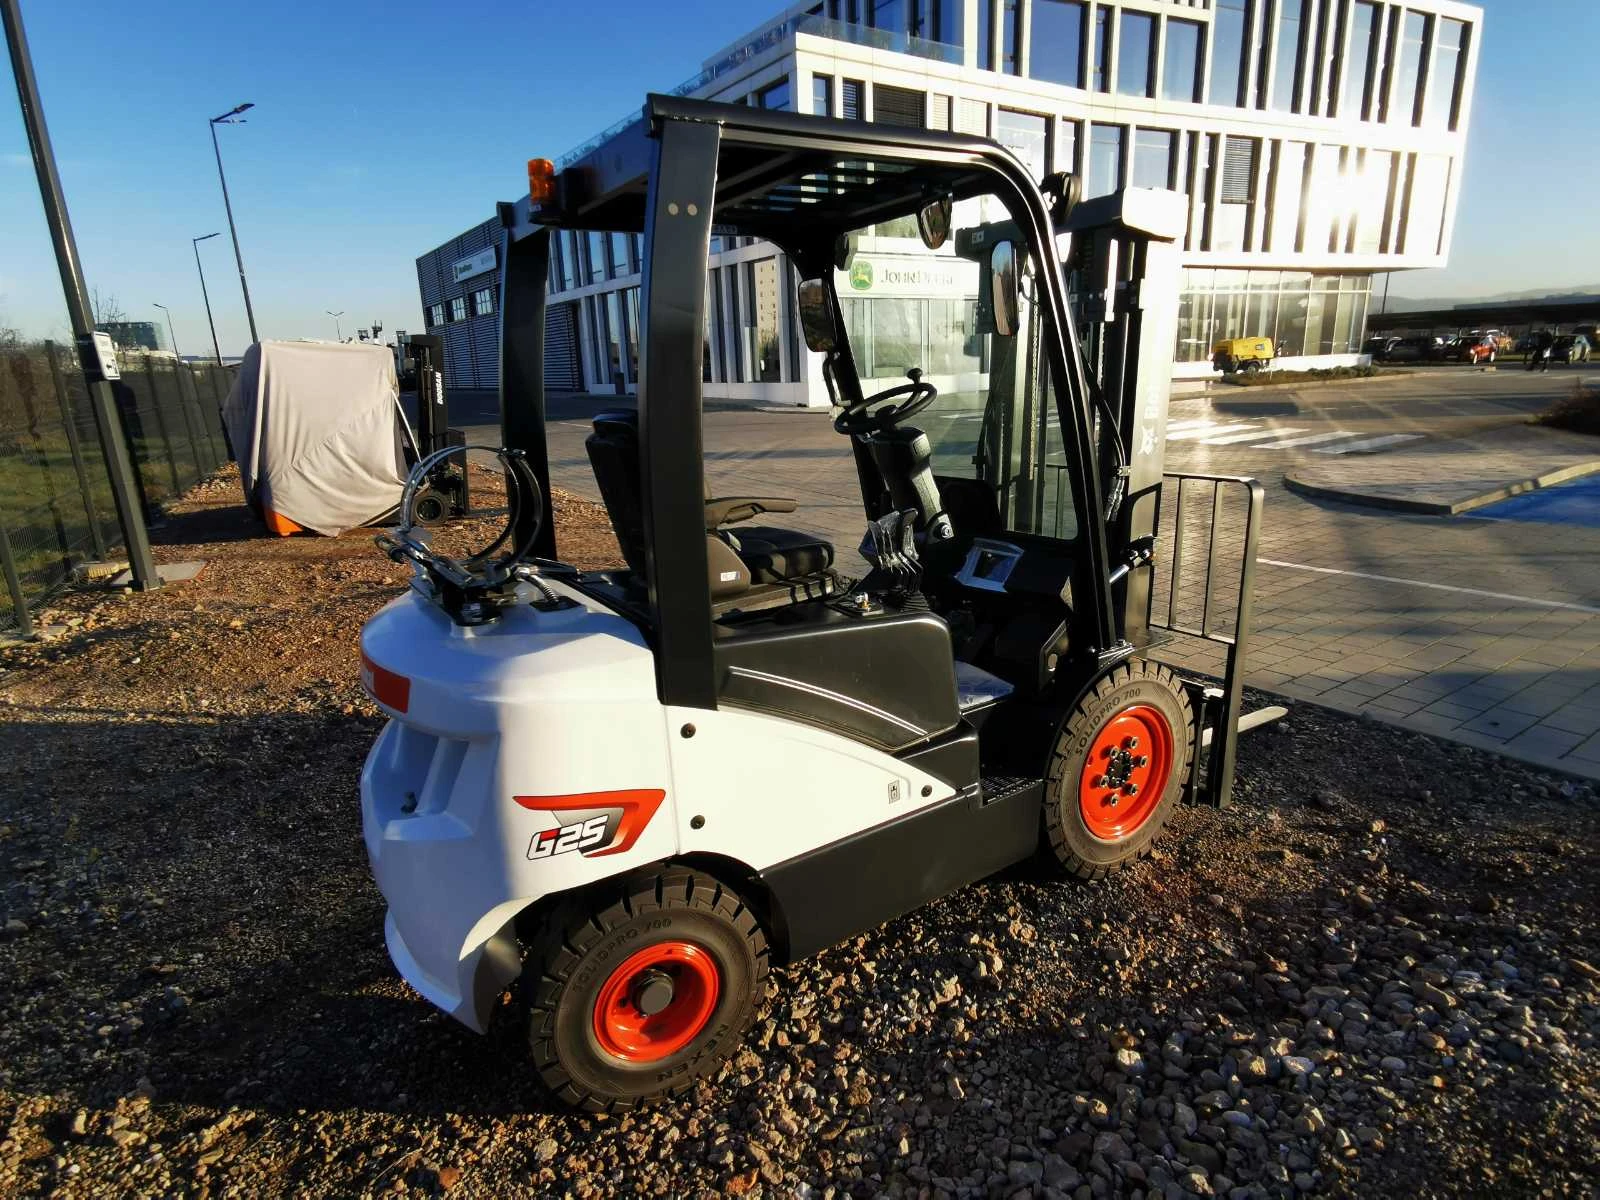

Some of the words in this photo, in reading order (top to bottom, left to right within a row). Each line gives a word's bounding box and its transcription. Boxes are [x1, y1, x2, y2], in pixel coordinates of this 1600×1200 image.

[1075, 696, 1120, 755] SOLIDPRO
[1123, 687, 1141, 700] 700
[526, 814, 609, 861] G25
[572, 928, 638, 993] SOLIDPRO
[657, 1024, 729, 1082] NEXEN
